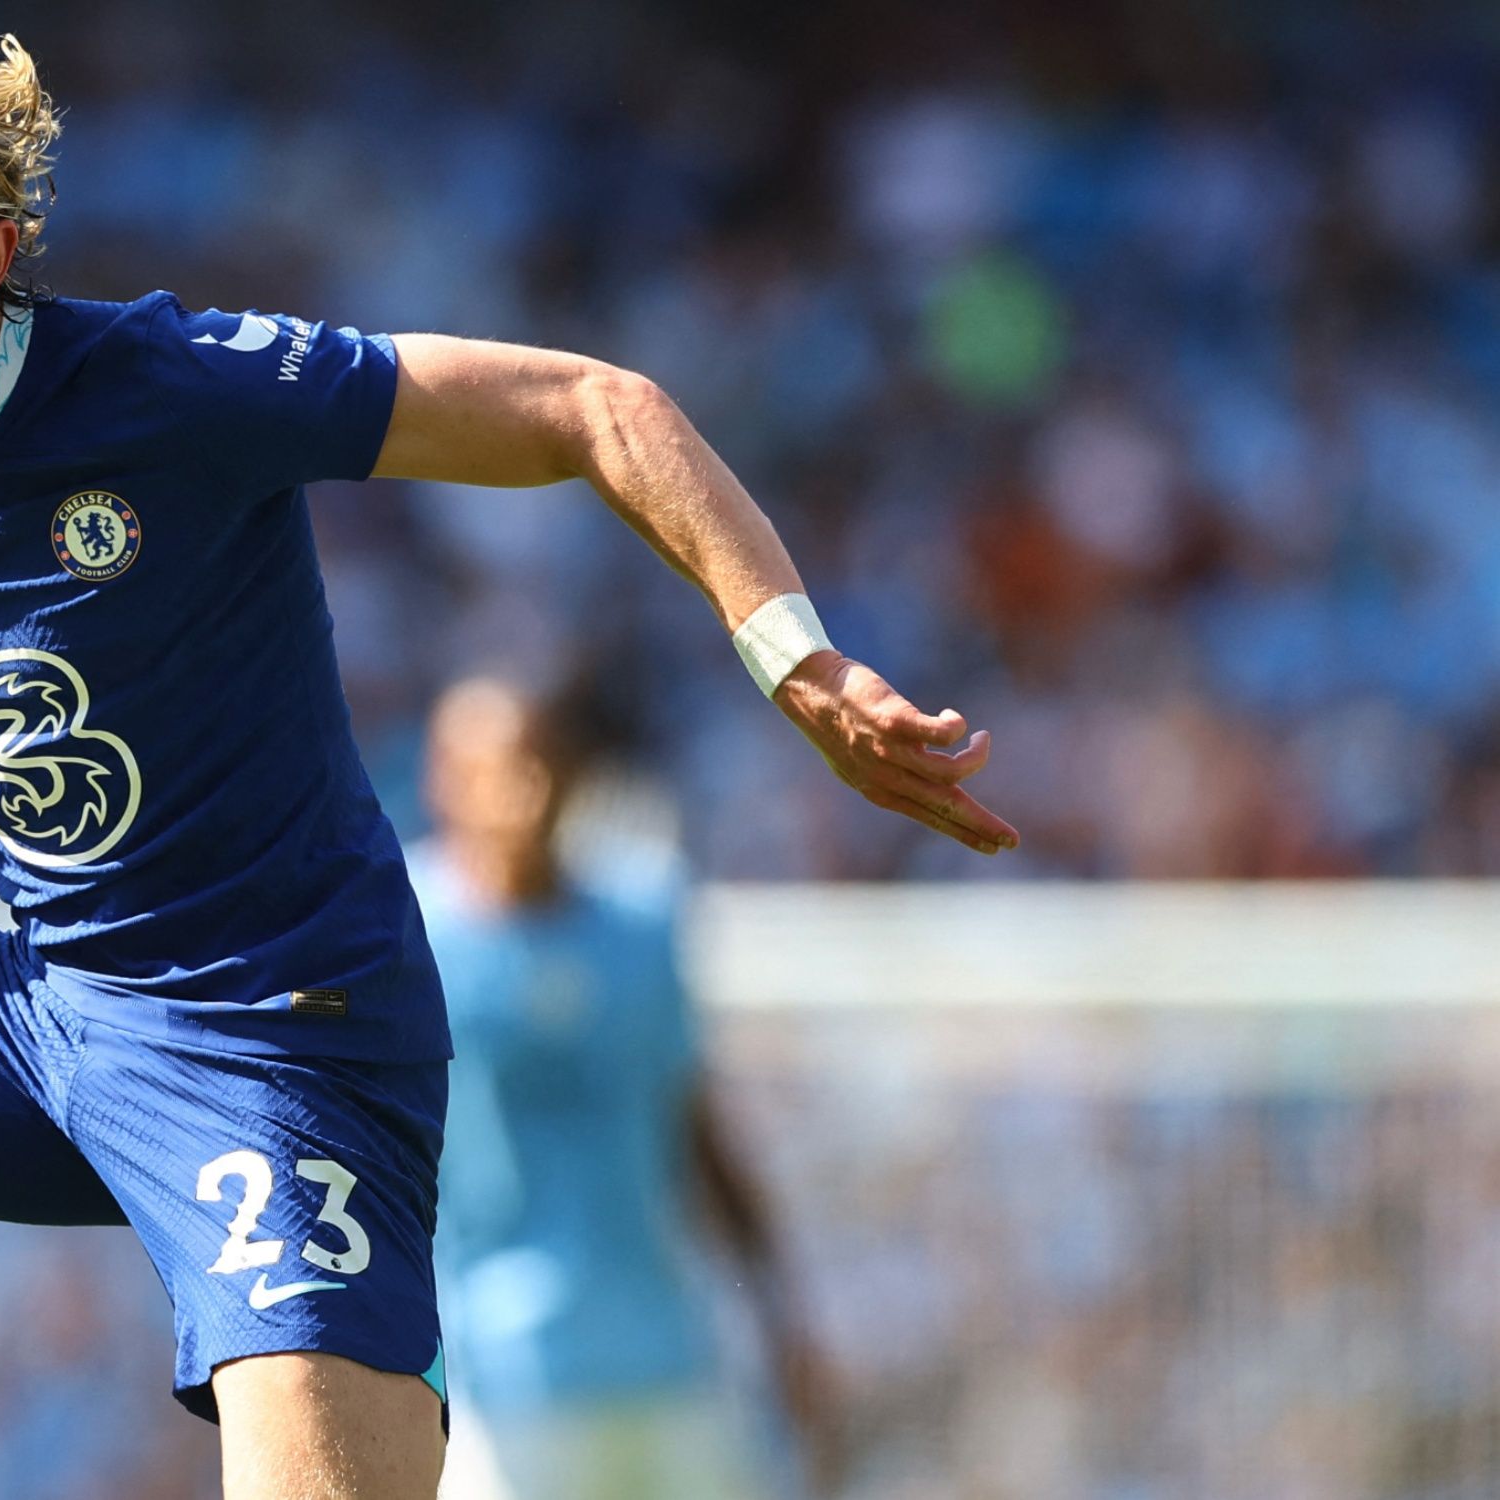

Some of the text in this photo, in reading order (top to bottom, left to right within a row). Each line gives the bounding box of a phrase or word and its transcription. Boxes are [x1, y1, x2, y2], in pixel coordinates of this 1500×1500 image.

[58, 494, 113, 521] CHELSEA
[75, 550, 133, 577] FOOTBALL CLUB
[195, 1149, 371, 1276] 23
